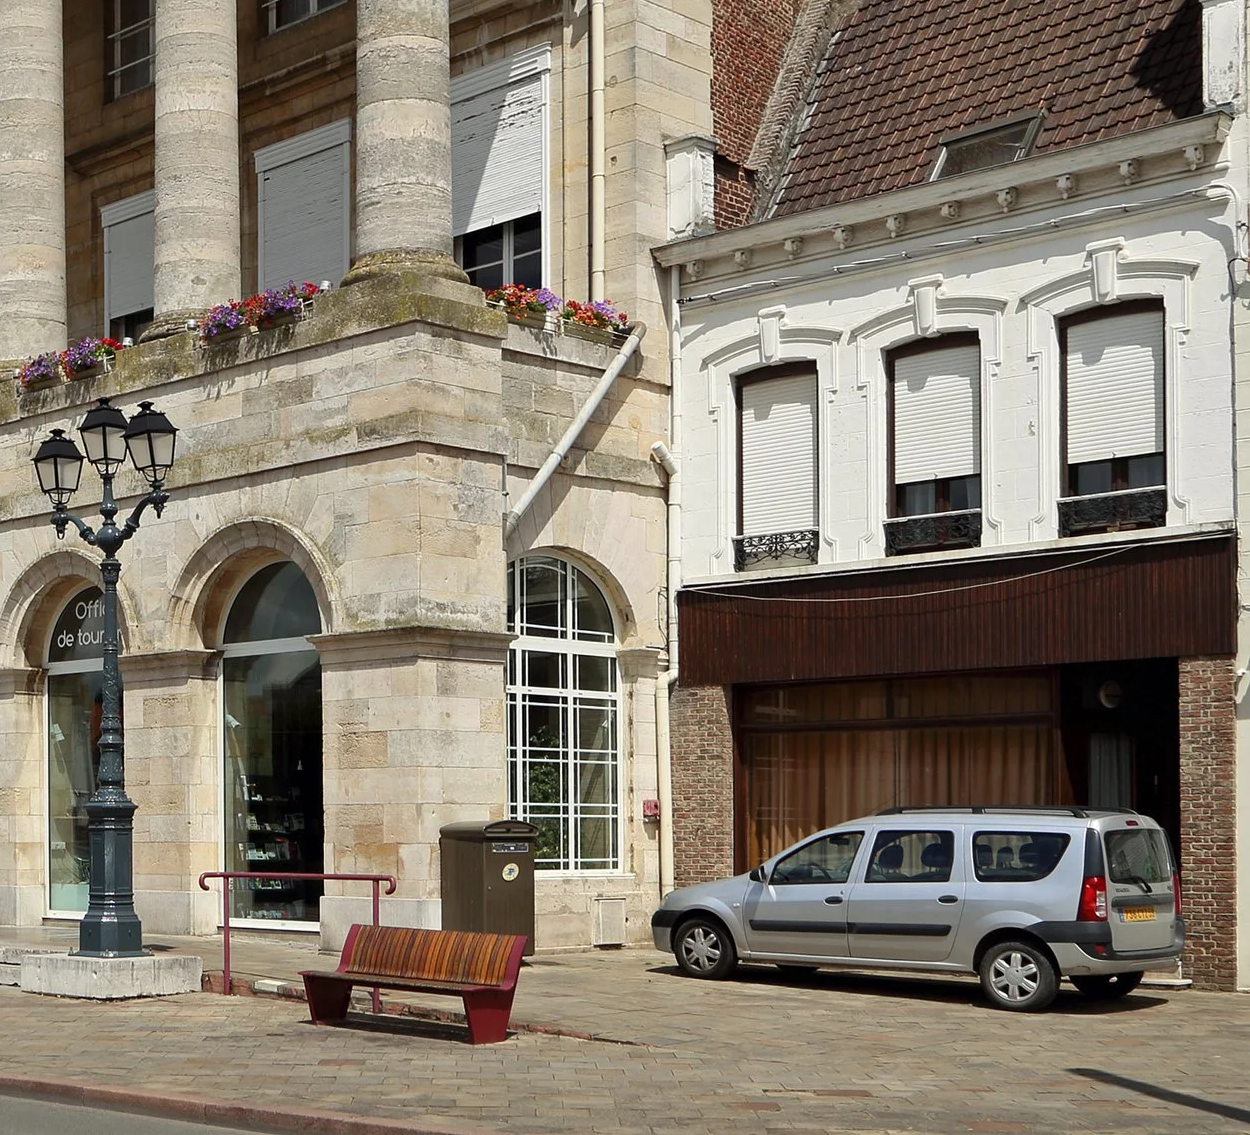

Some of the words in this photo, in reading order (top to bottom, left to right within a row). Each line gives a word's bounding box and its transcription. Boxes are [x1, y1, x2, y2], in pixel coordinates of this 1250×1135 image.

[75, 600, 105, 620] Offi
[57, 630, 74, 648] de
[77, 628, 121, 646] tour
